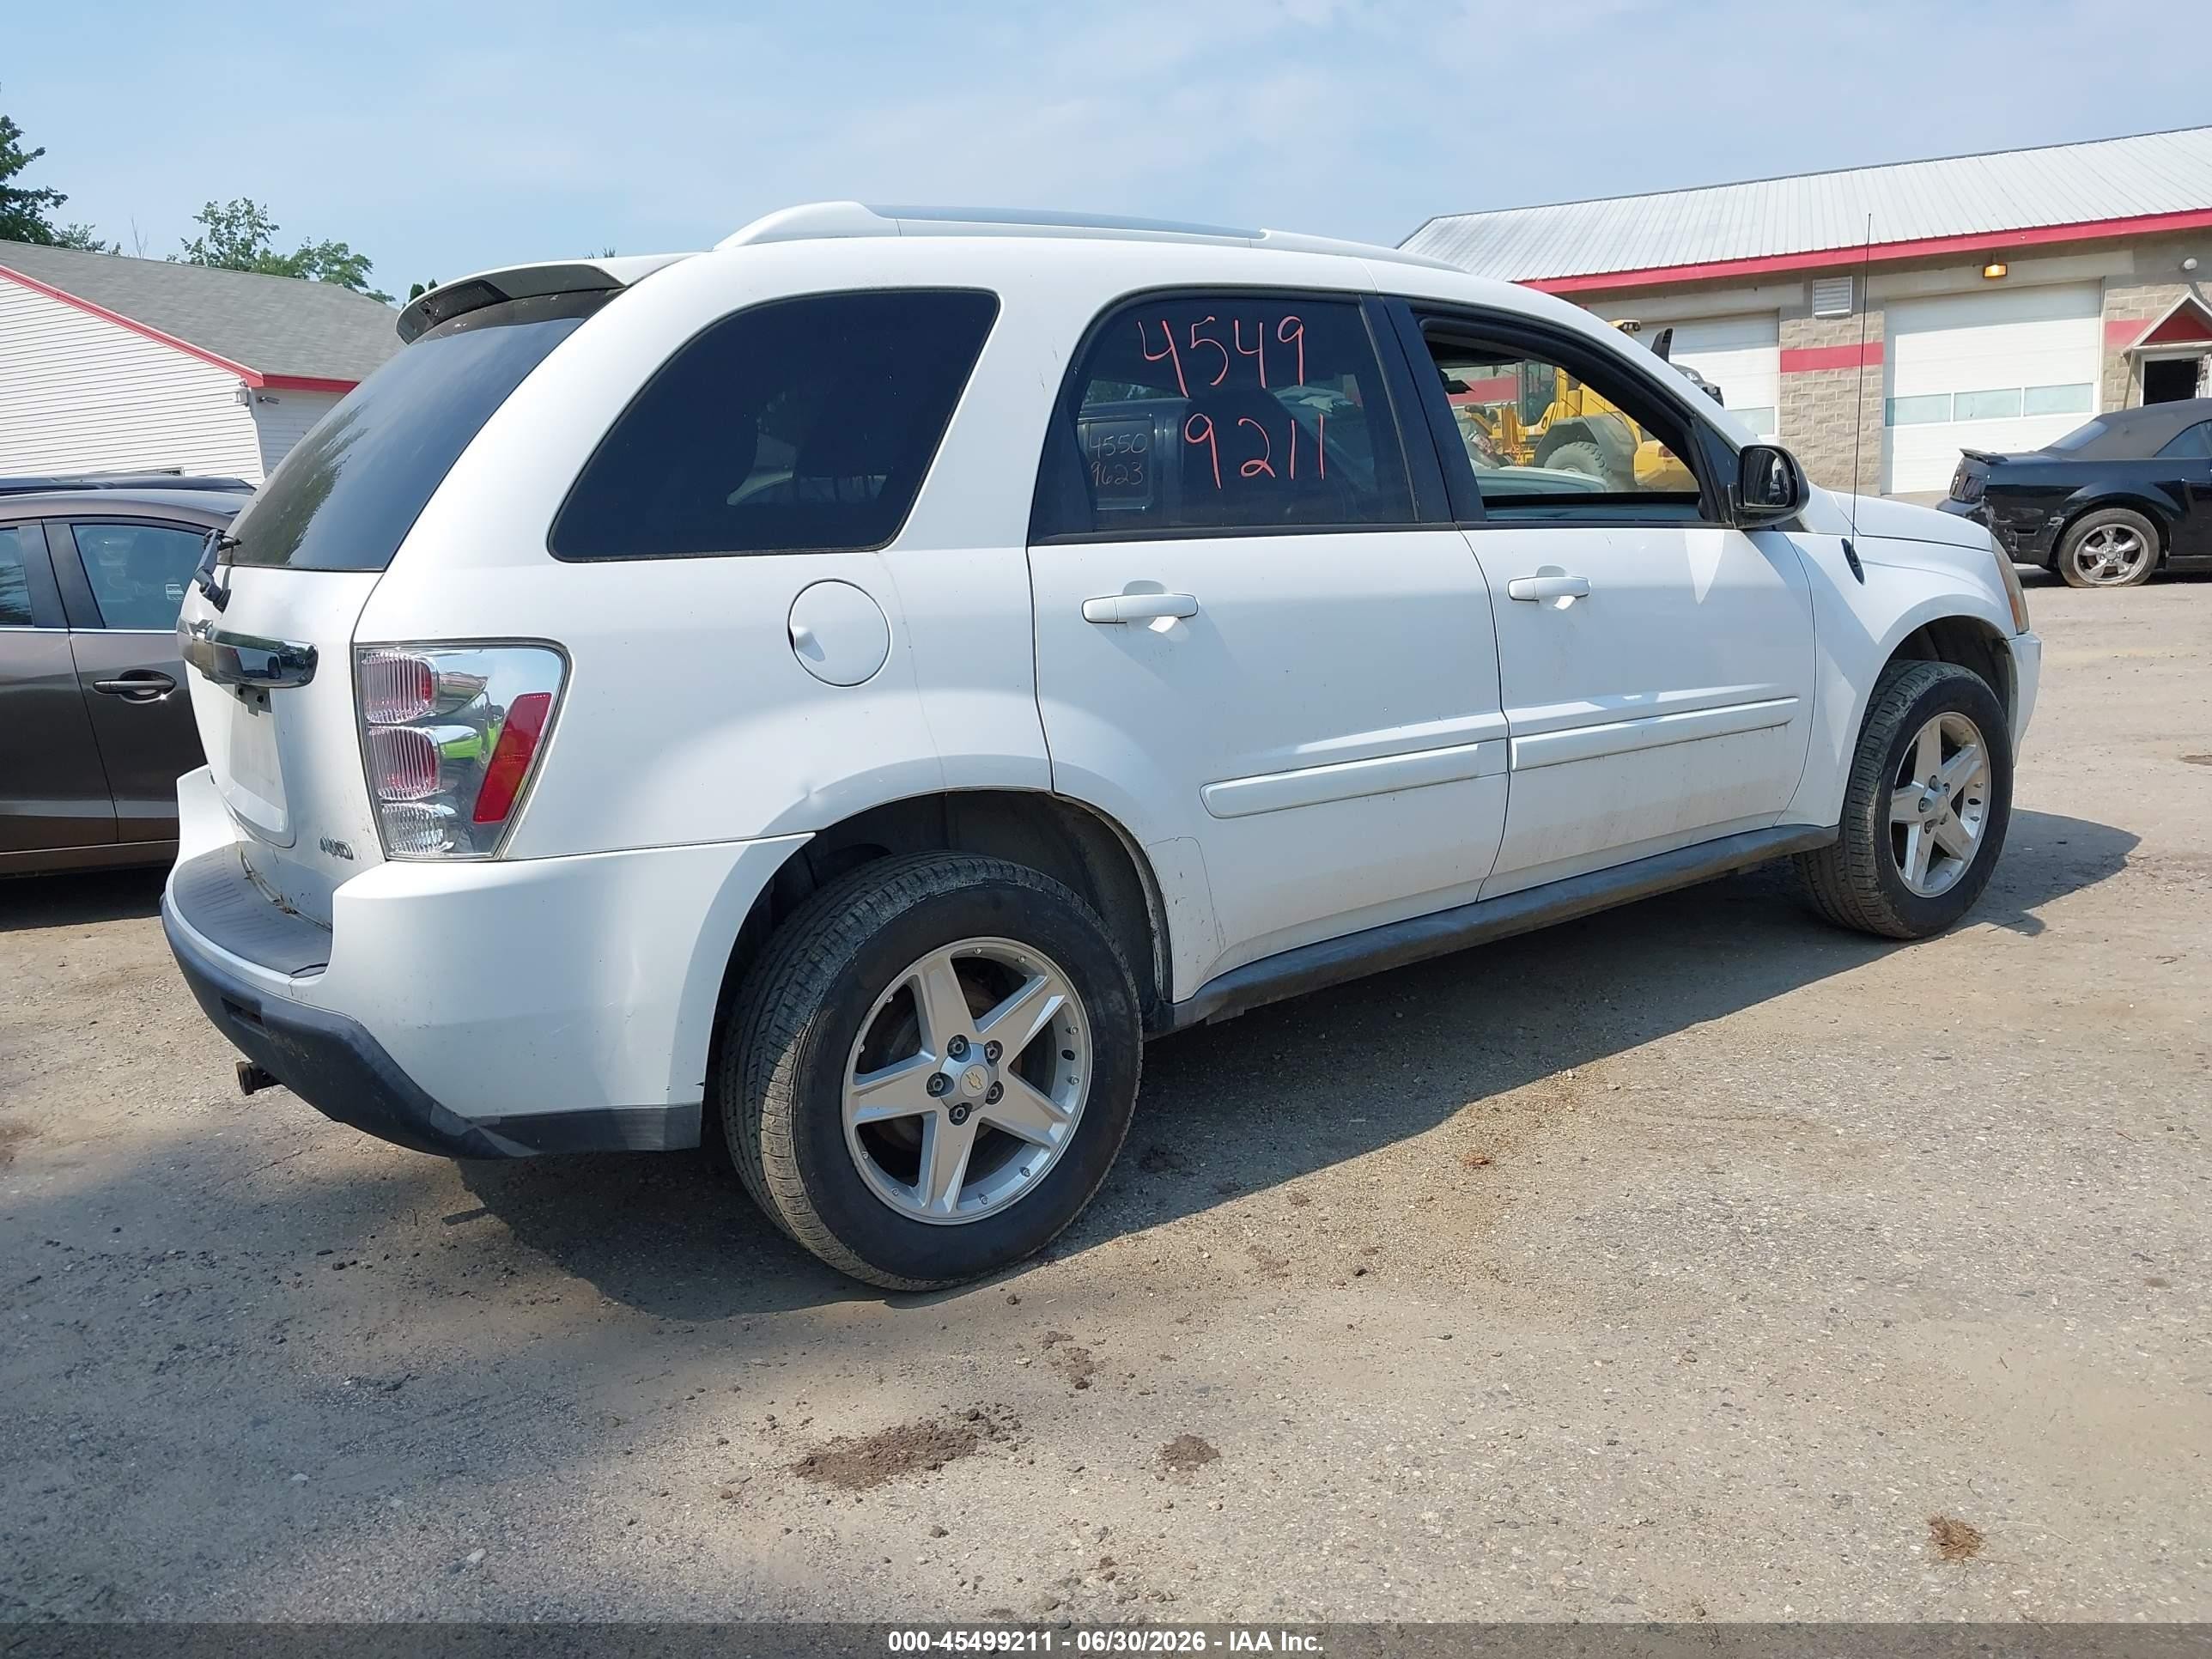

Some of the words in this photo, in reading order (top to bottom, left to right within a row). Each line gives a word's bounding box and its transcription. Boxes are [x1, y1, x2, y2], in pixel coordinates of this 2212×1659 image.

[1137, 315, 1304, 398] 4549
[1089, 433, 1148, 459] 4550
[1184, 412, 1325, 489] 9211
[1091, 461, 1144, 487] 9623
